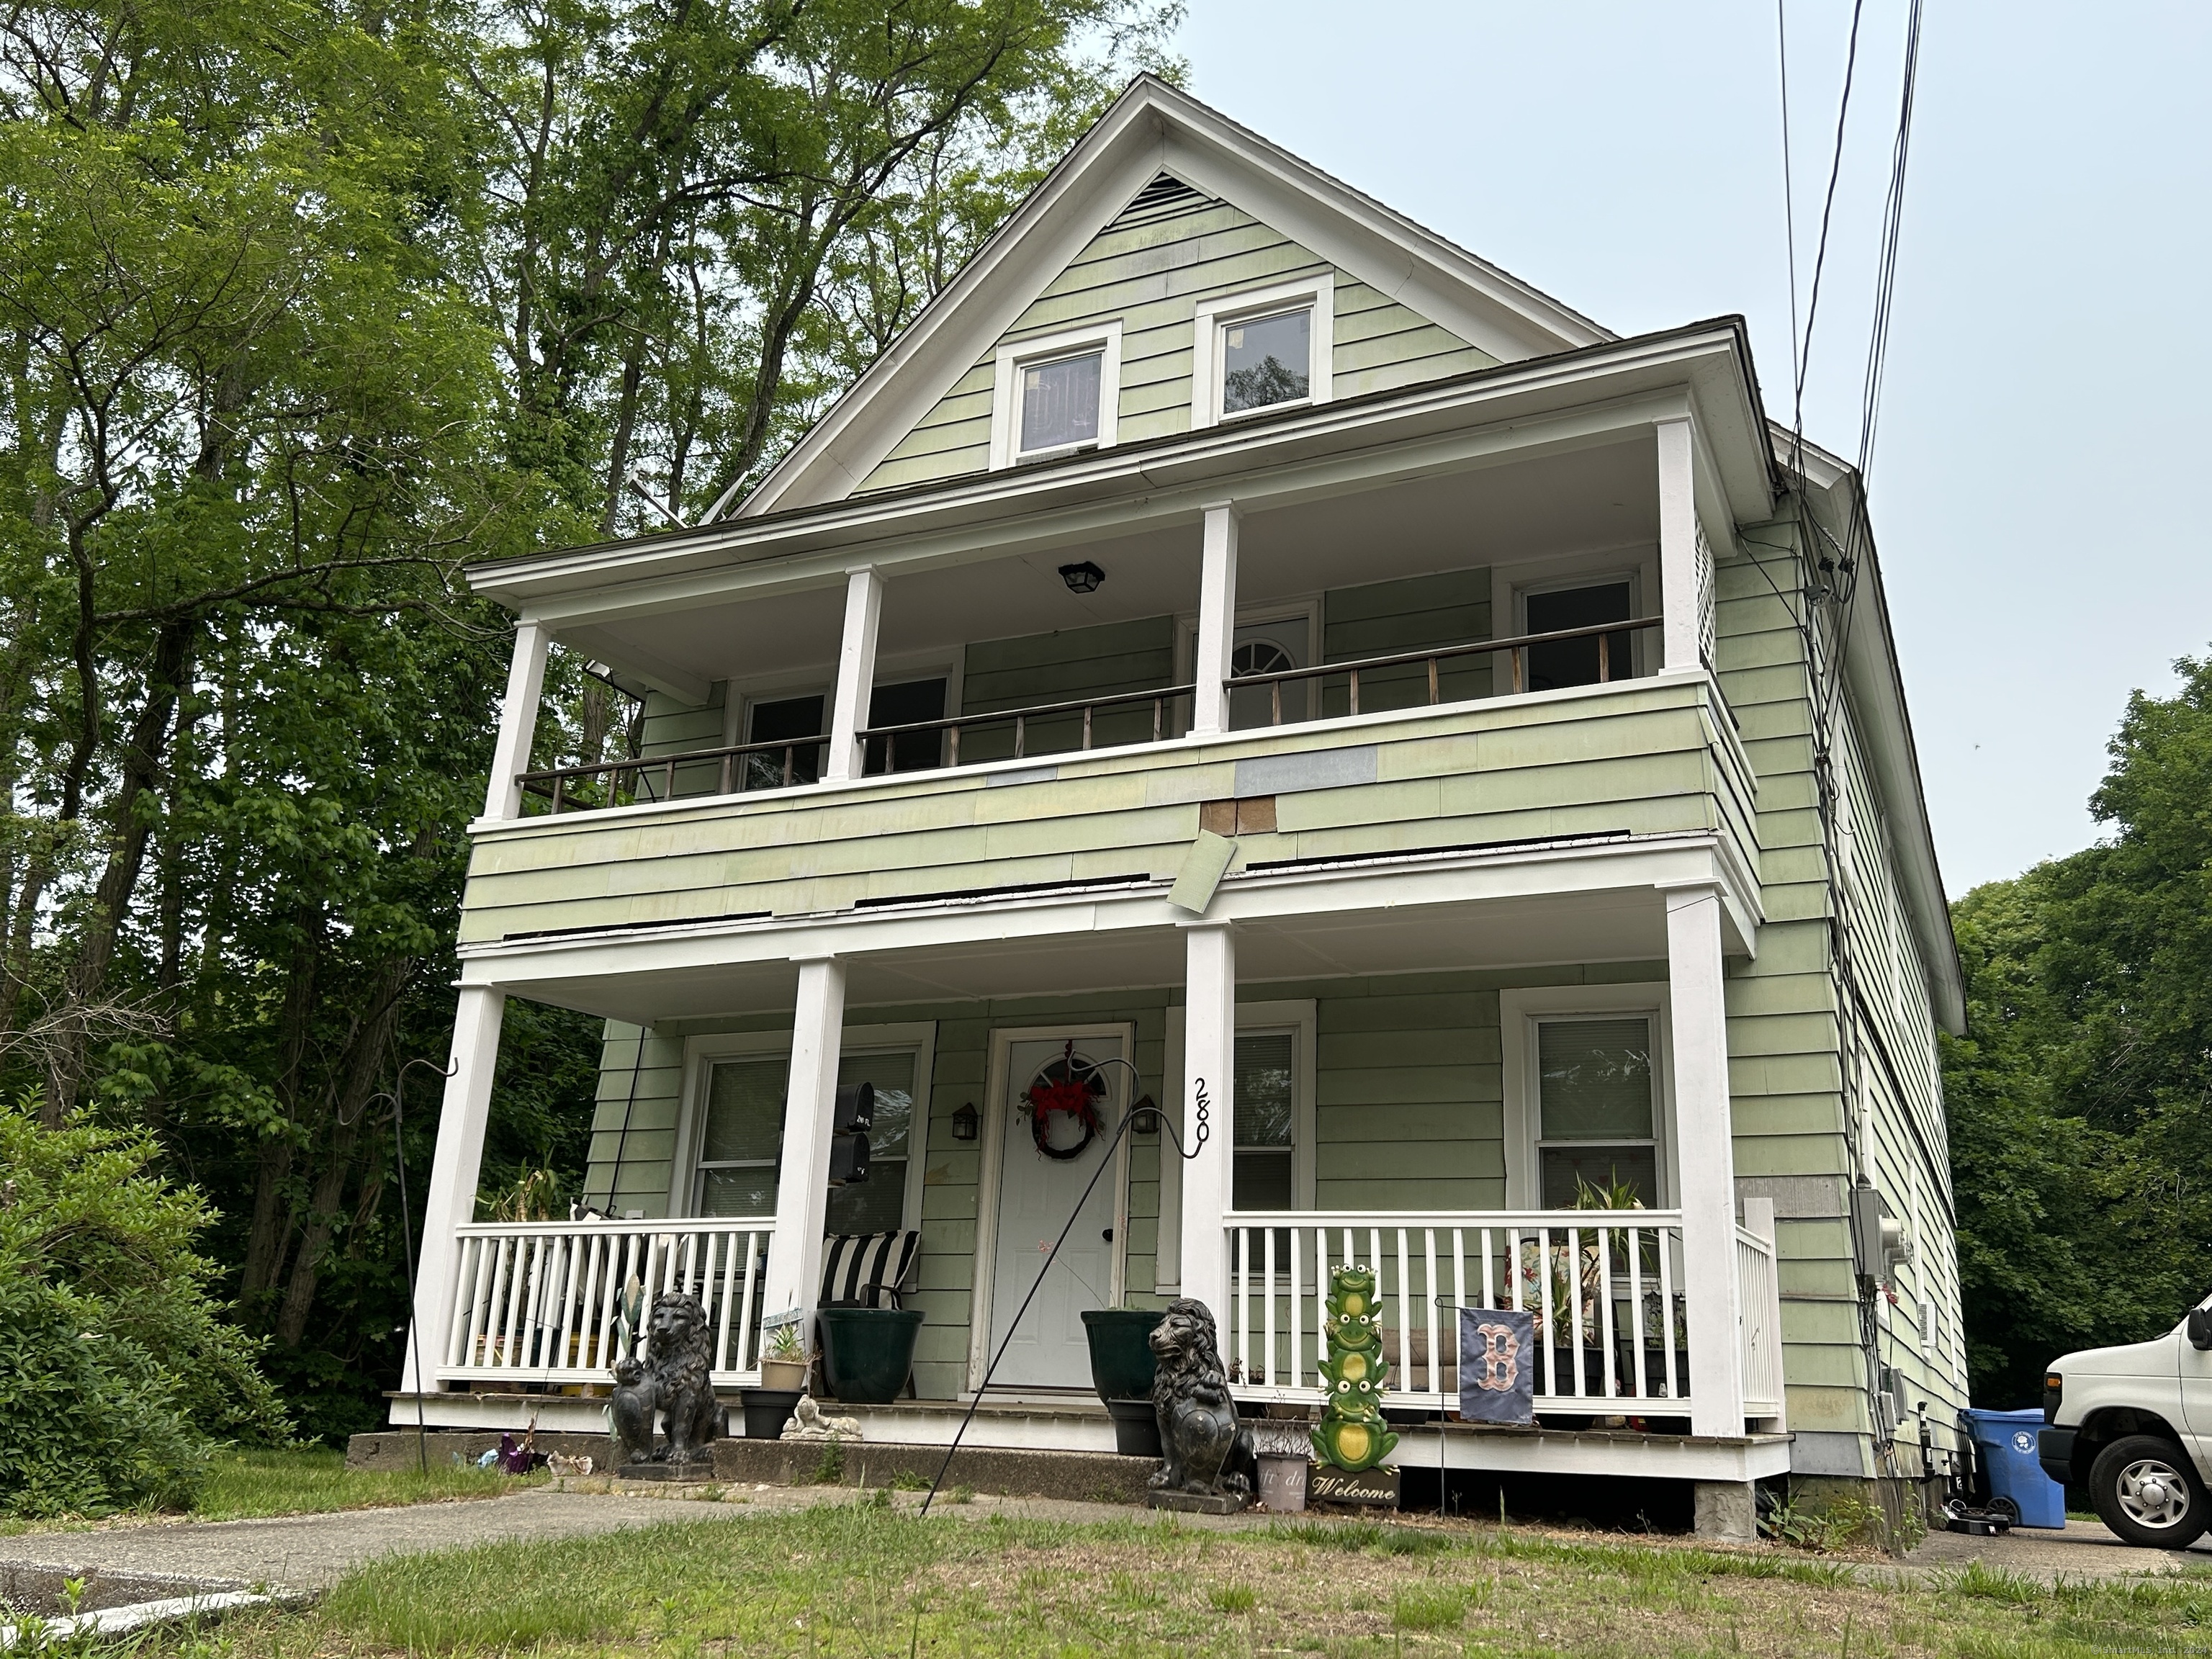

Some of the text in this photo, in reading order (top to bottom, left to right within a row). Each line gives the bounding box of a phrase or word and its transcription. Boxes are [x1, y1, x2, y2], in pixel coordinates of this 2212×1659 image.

[1195, 1077, 1210, 1142] 280
[1478, 1323, 1520, 1391] B
[1312, 1476, 1395, 1500] Welcome
